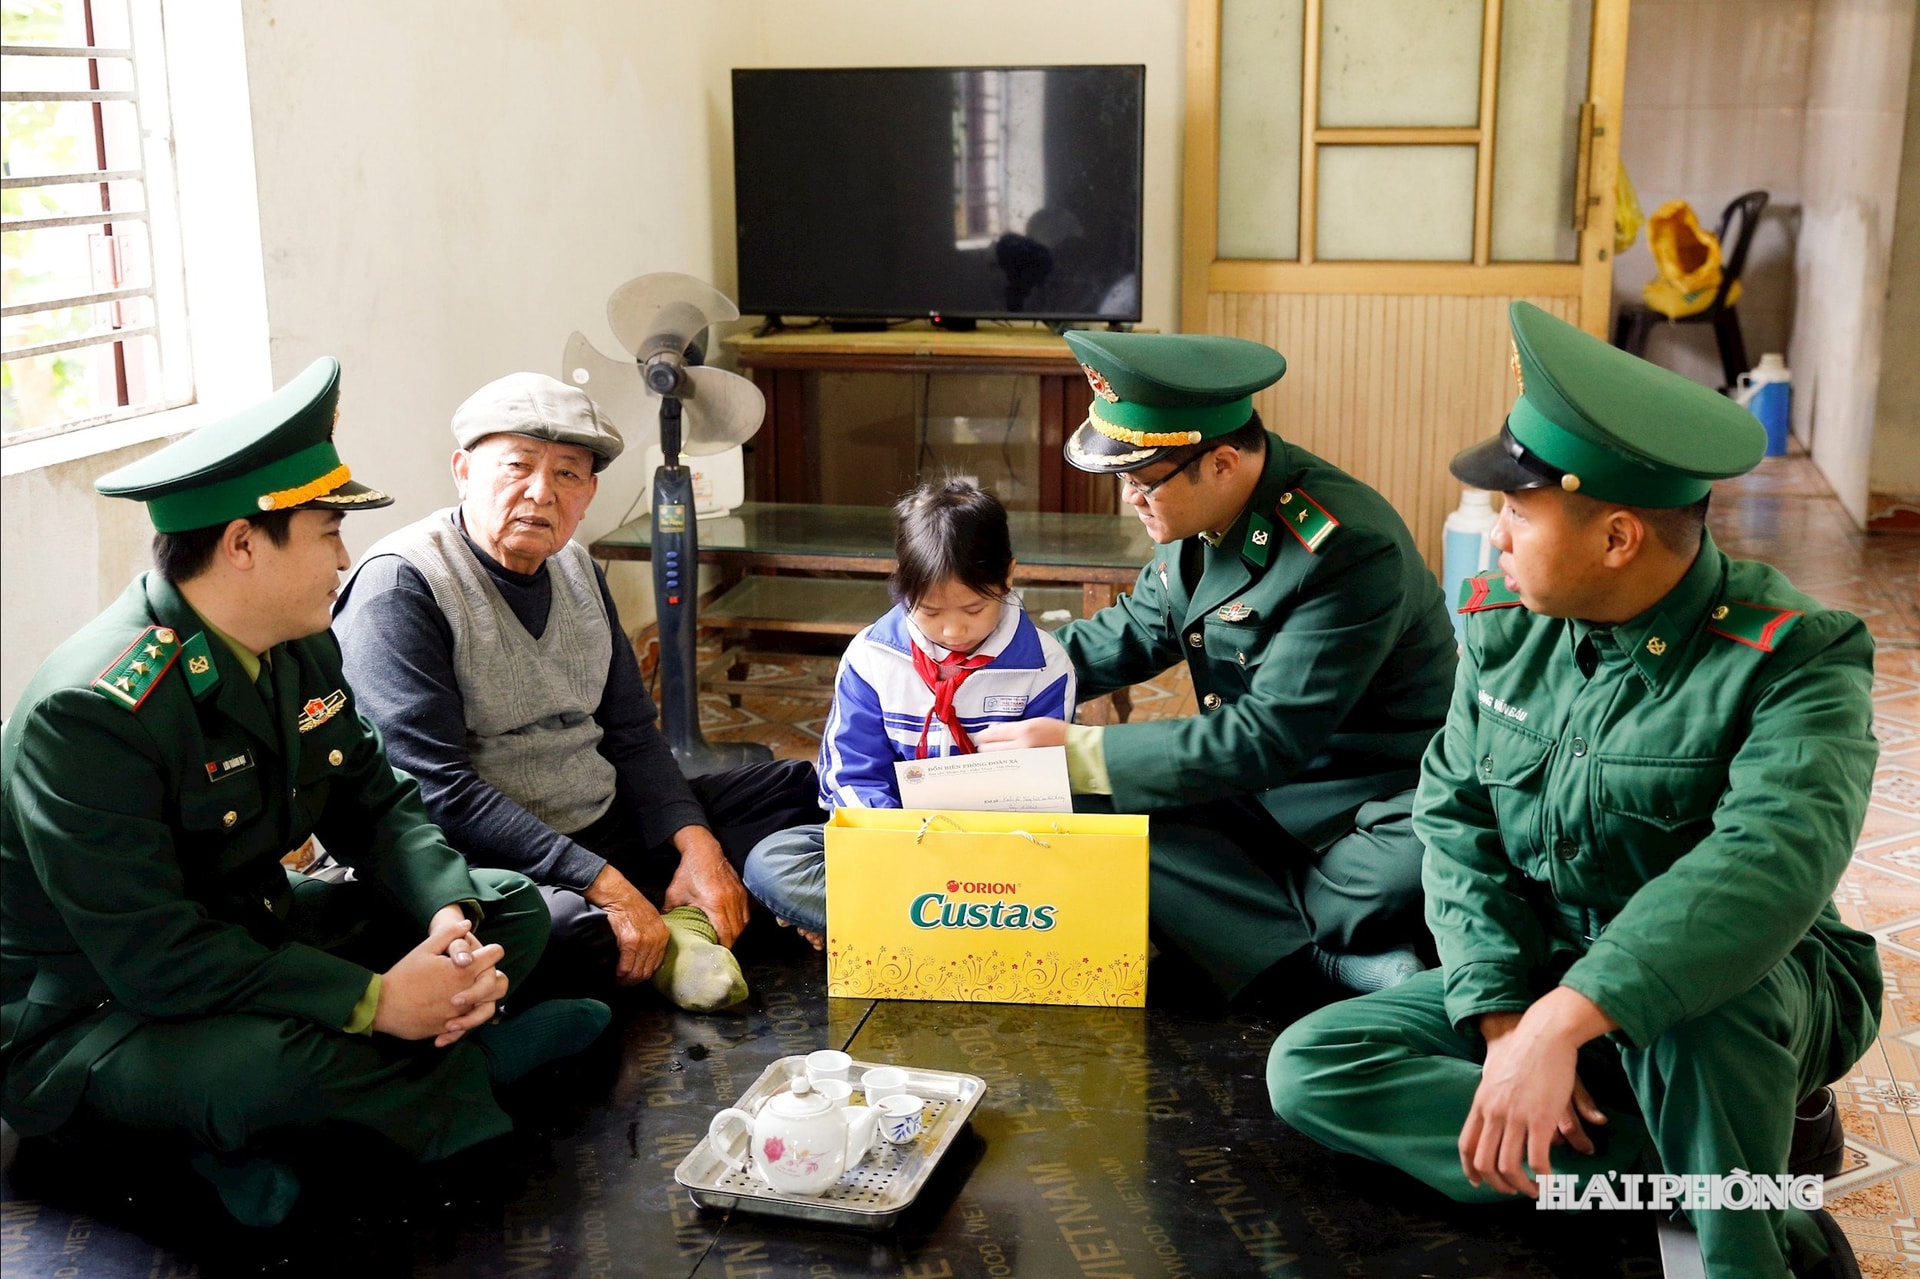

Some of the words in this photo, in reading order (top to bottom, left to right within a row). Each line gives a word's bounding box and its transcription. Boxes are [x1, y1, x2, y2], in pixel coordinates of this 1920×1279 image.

[962, 881, 1016, 895] ORION
[910, 891, 1059, 931] Custas
[1177, 1144, 1299, 1273] VIETNAM
